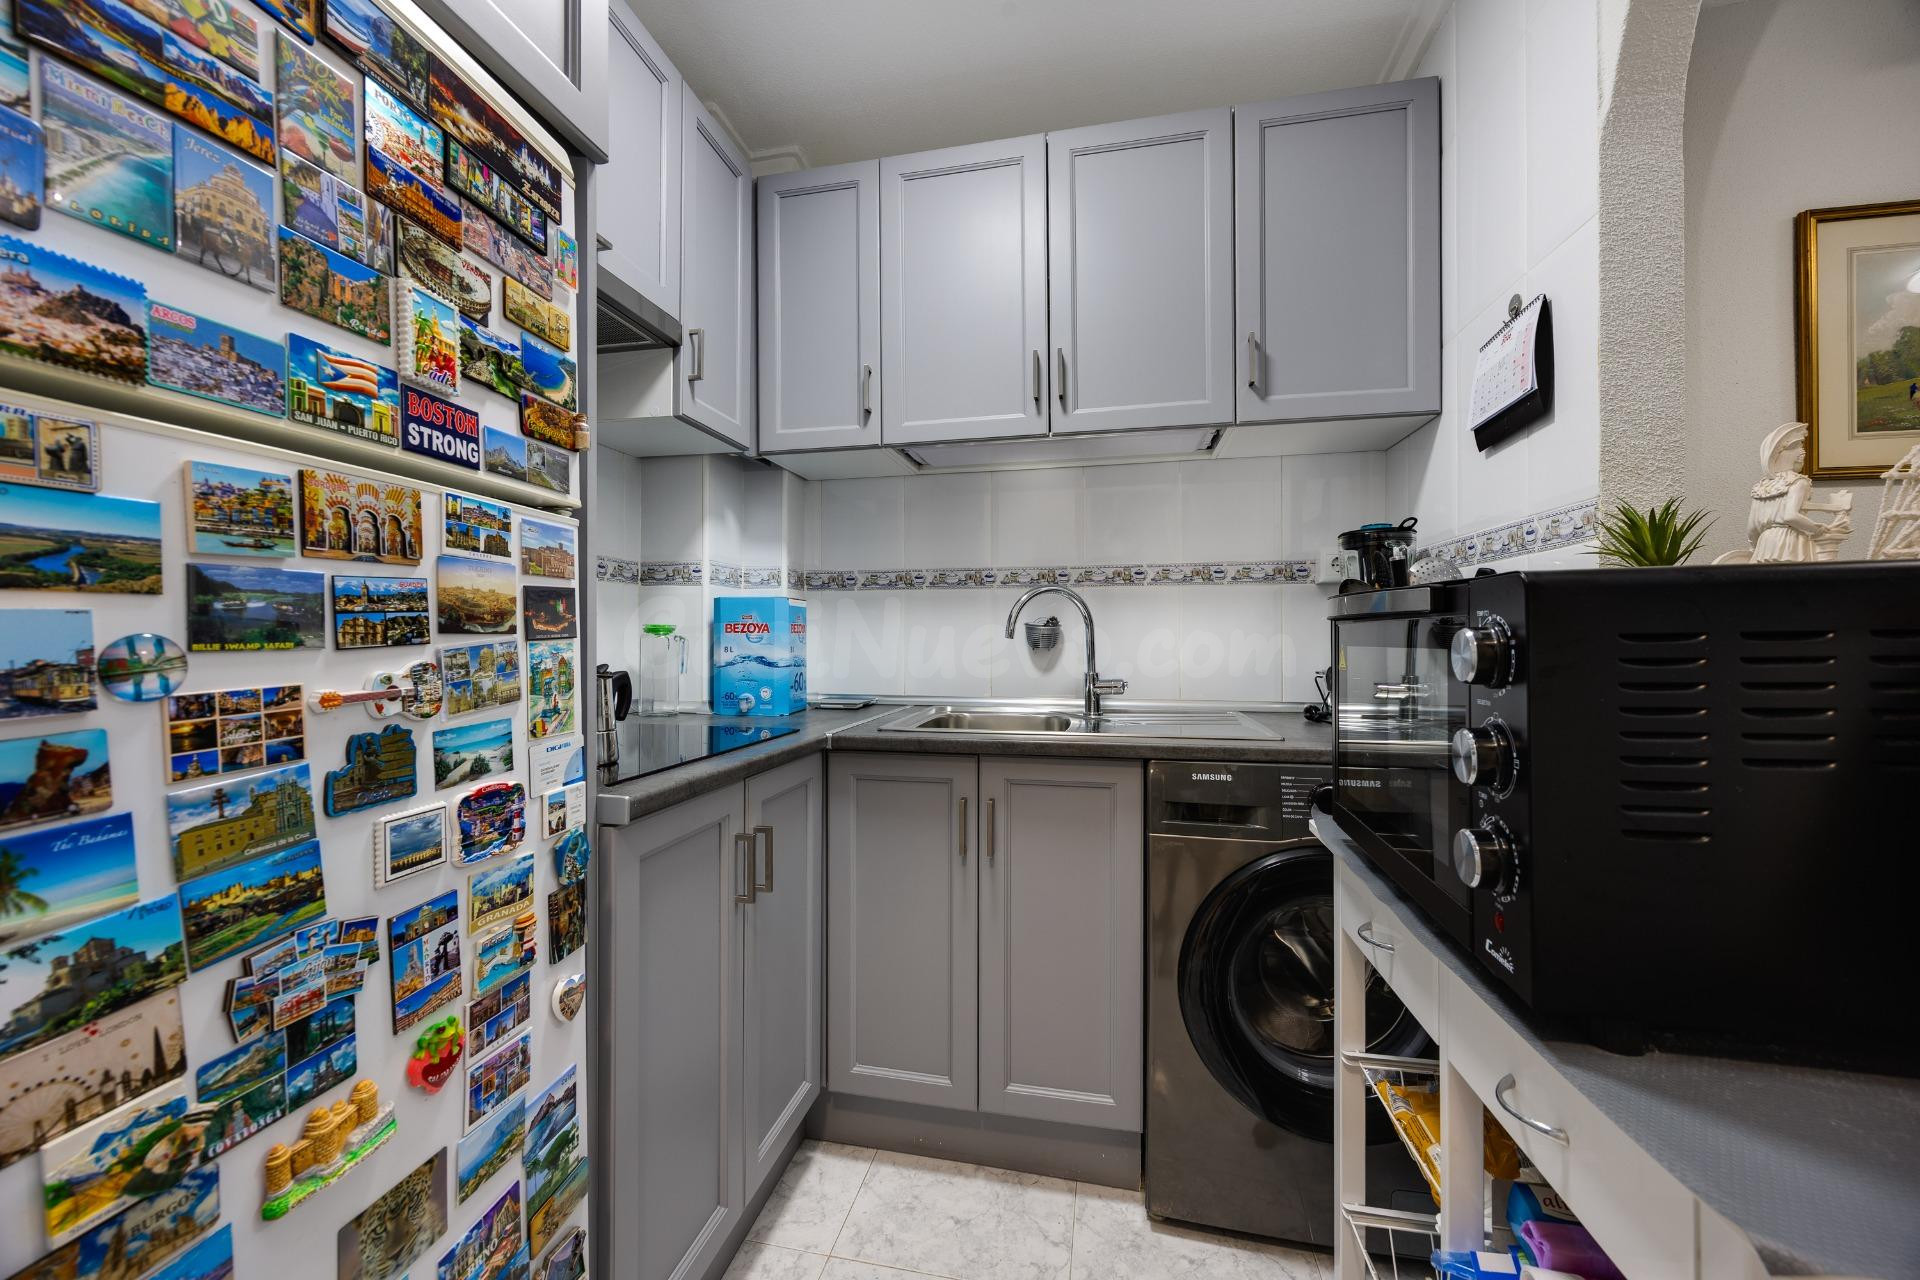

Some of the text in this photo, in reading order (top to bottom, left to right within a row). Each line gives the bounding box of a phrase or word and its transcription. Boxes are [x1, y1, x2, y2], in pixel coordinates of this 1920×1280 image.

[185, 136, 221, 164] Jerez
[151, 304, 197, 330] ARCOS
[407, 391, 478, 438] BOSTON
[294, 411, 398, 446] SAN JUAN PUERTO RICO
[408, 422, 479, 464] STRONG
[724, 623, 771, 634] BEZOYA
[224, 642, 261, 650] SWAMP
[263, 641, 295, 649] SAFARI
[1191, 772, 1232, 782] SAMSUNG
[51, 825, 128, 852] The Bahamas
[244, 841, 277, 856] Caravaca
[477, 900, 530, 927] GRANADA
[130, 1187, 199, 1238] BURGOS
